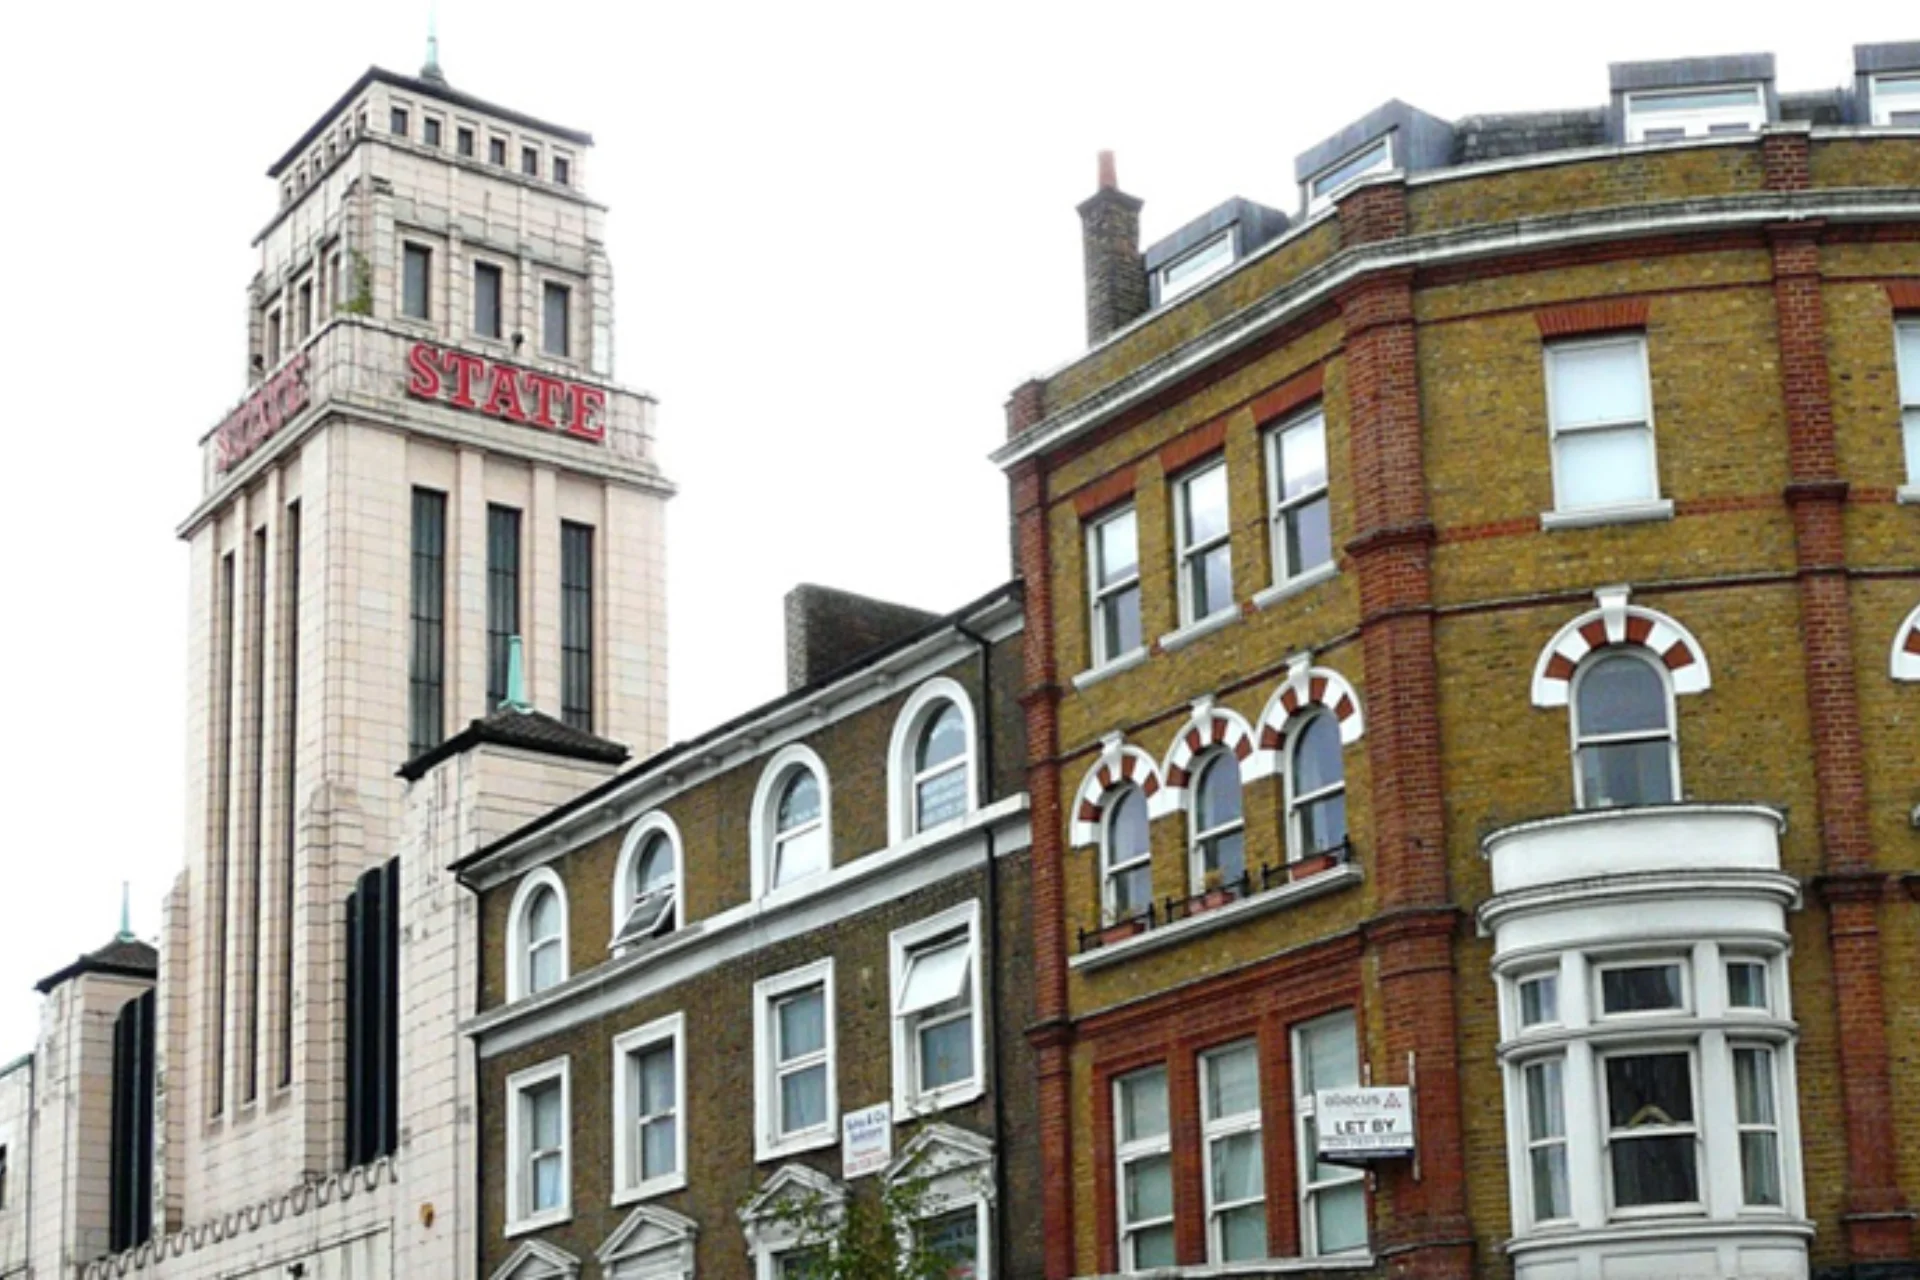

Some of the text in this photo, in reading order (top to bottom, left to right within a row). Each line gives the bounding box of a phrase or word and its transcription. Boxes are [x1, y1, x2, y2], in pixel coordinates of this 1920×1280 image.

[215, 355, 310, 472] STATE
[409, 341, 606, 442] STATE
[1334, 1117, 1396, 1135] LET BY
